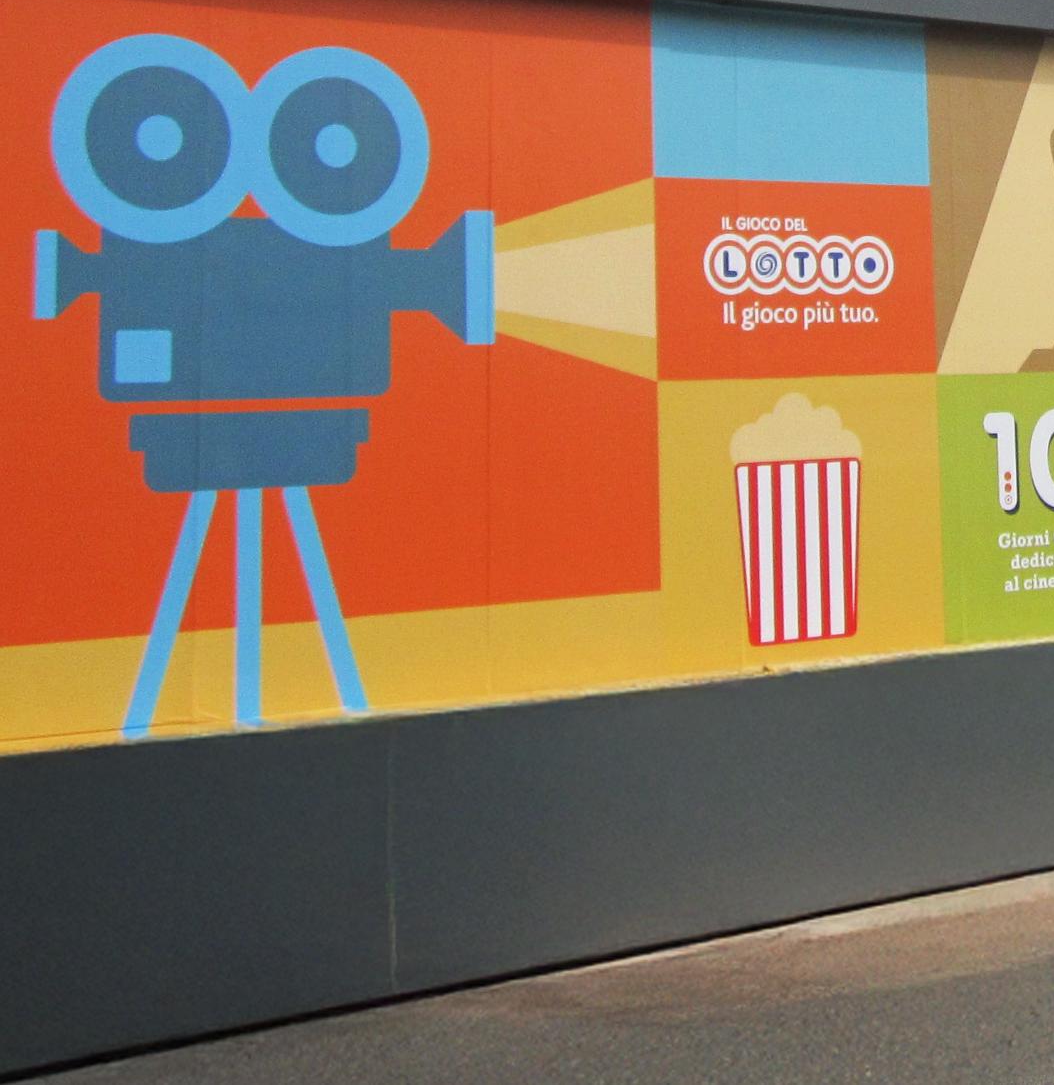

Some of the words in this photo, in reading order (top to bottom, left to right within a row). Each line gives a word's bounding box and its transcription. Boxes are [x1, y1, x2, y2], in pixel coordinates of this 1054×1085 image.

[721, 216, 732, 230] IL
[736, 217, 781, 231] GIOCO
[784, 218, 808, 232] DEL
[710, 240, 889, 290] LOTTO
[723, 301, 736, 324] Il
[741, 301, 798, 331] gioco
[803, 301, 835, 330] più
[840, 303, 879, 324] tuo.
[998, 530, 1049, 549] Giorni
[1004, 576, 1020, 592] al
